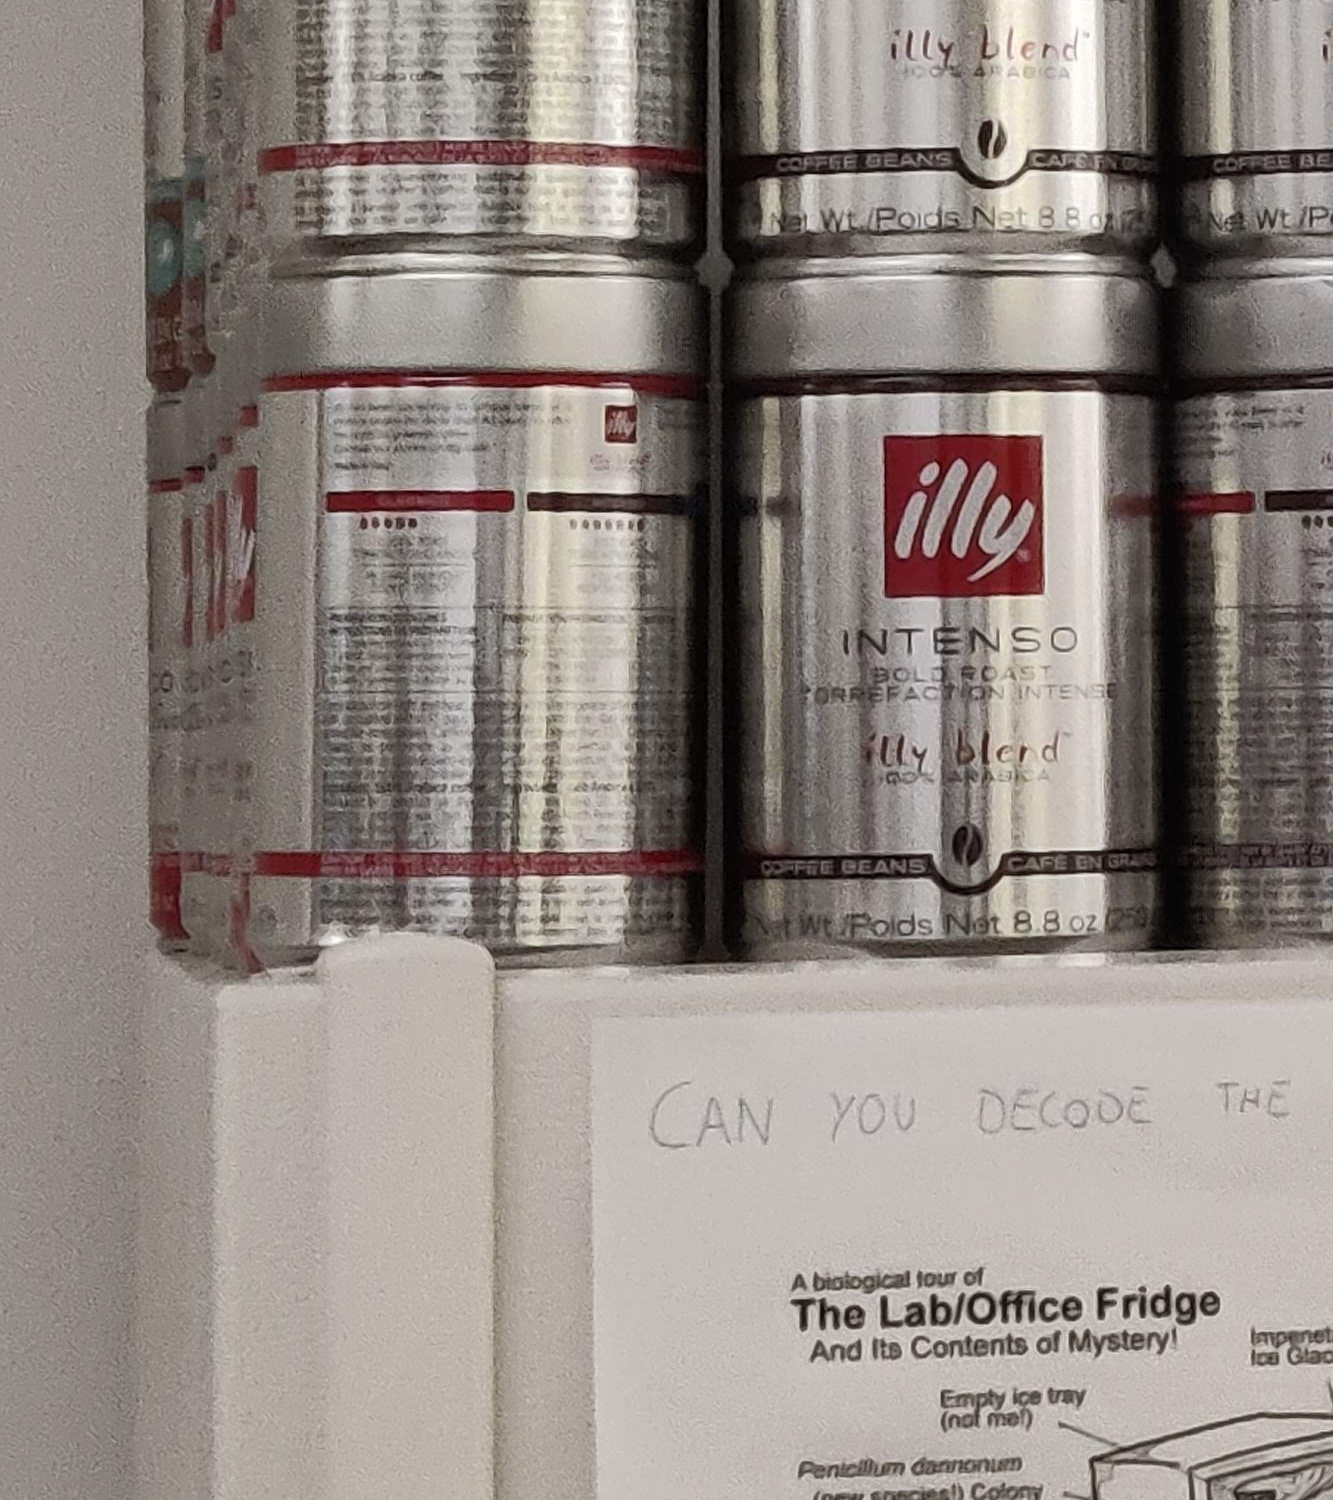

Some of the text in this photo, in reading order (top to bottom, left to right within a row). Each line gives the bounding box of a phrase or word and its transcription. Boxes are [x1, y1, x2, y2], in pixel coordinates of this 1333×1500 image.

[895, 457, 1035, 583] illy
[842, 625, 1078, 655] INTENSO
[842, 857, 928, 875] BEANS
[1013, 910, 1097, 934] 8.8 oz
[650, 1081, 773, 1149] CAN
[831, 1092, 915, 1143] YOU
[978, 1086, 1152, 1135] DECODE
[1217, 1079, 1290, 1117] THE
[791, 1267, 984, 1293] A biological tour of
[791, 1286, 1221, 1331] The Lab/Office Fridge
[810, 1328, 1177, 1363] And Its Contents of Mystery!
[1251, 1348, 1279, 1366] Ice
[941, 1387, 1086, 1411] Empty ice tray
